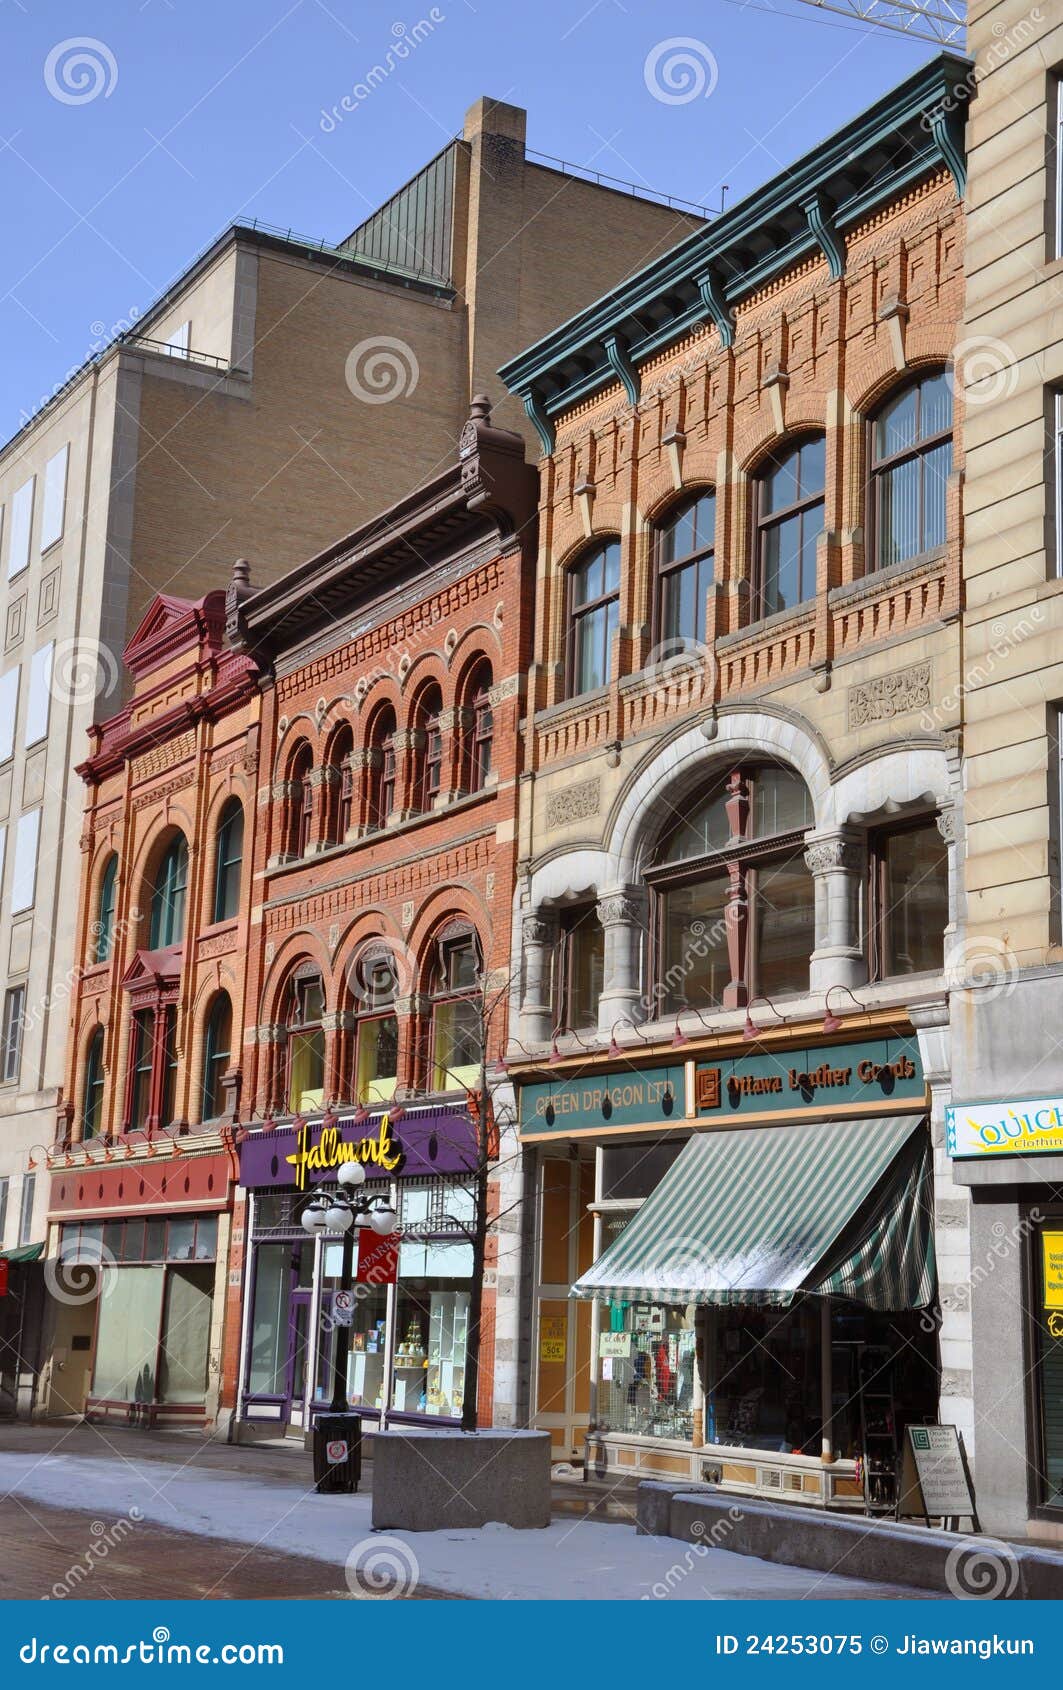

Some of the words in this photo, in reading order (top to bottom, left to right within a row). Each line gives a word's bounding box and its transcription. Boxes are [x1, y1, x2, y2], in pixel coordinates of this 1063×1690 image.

[583, 1083, 643, 1111] DRAGON
[727, 1074, 783, 1097] Ottawa
[857, 1055, 916, 1084] Gods
[286, 1114, 401, 1191] Hallmark
